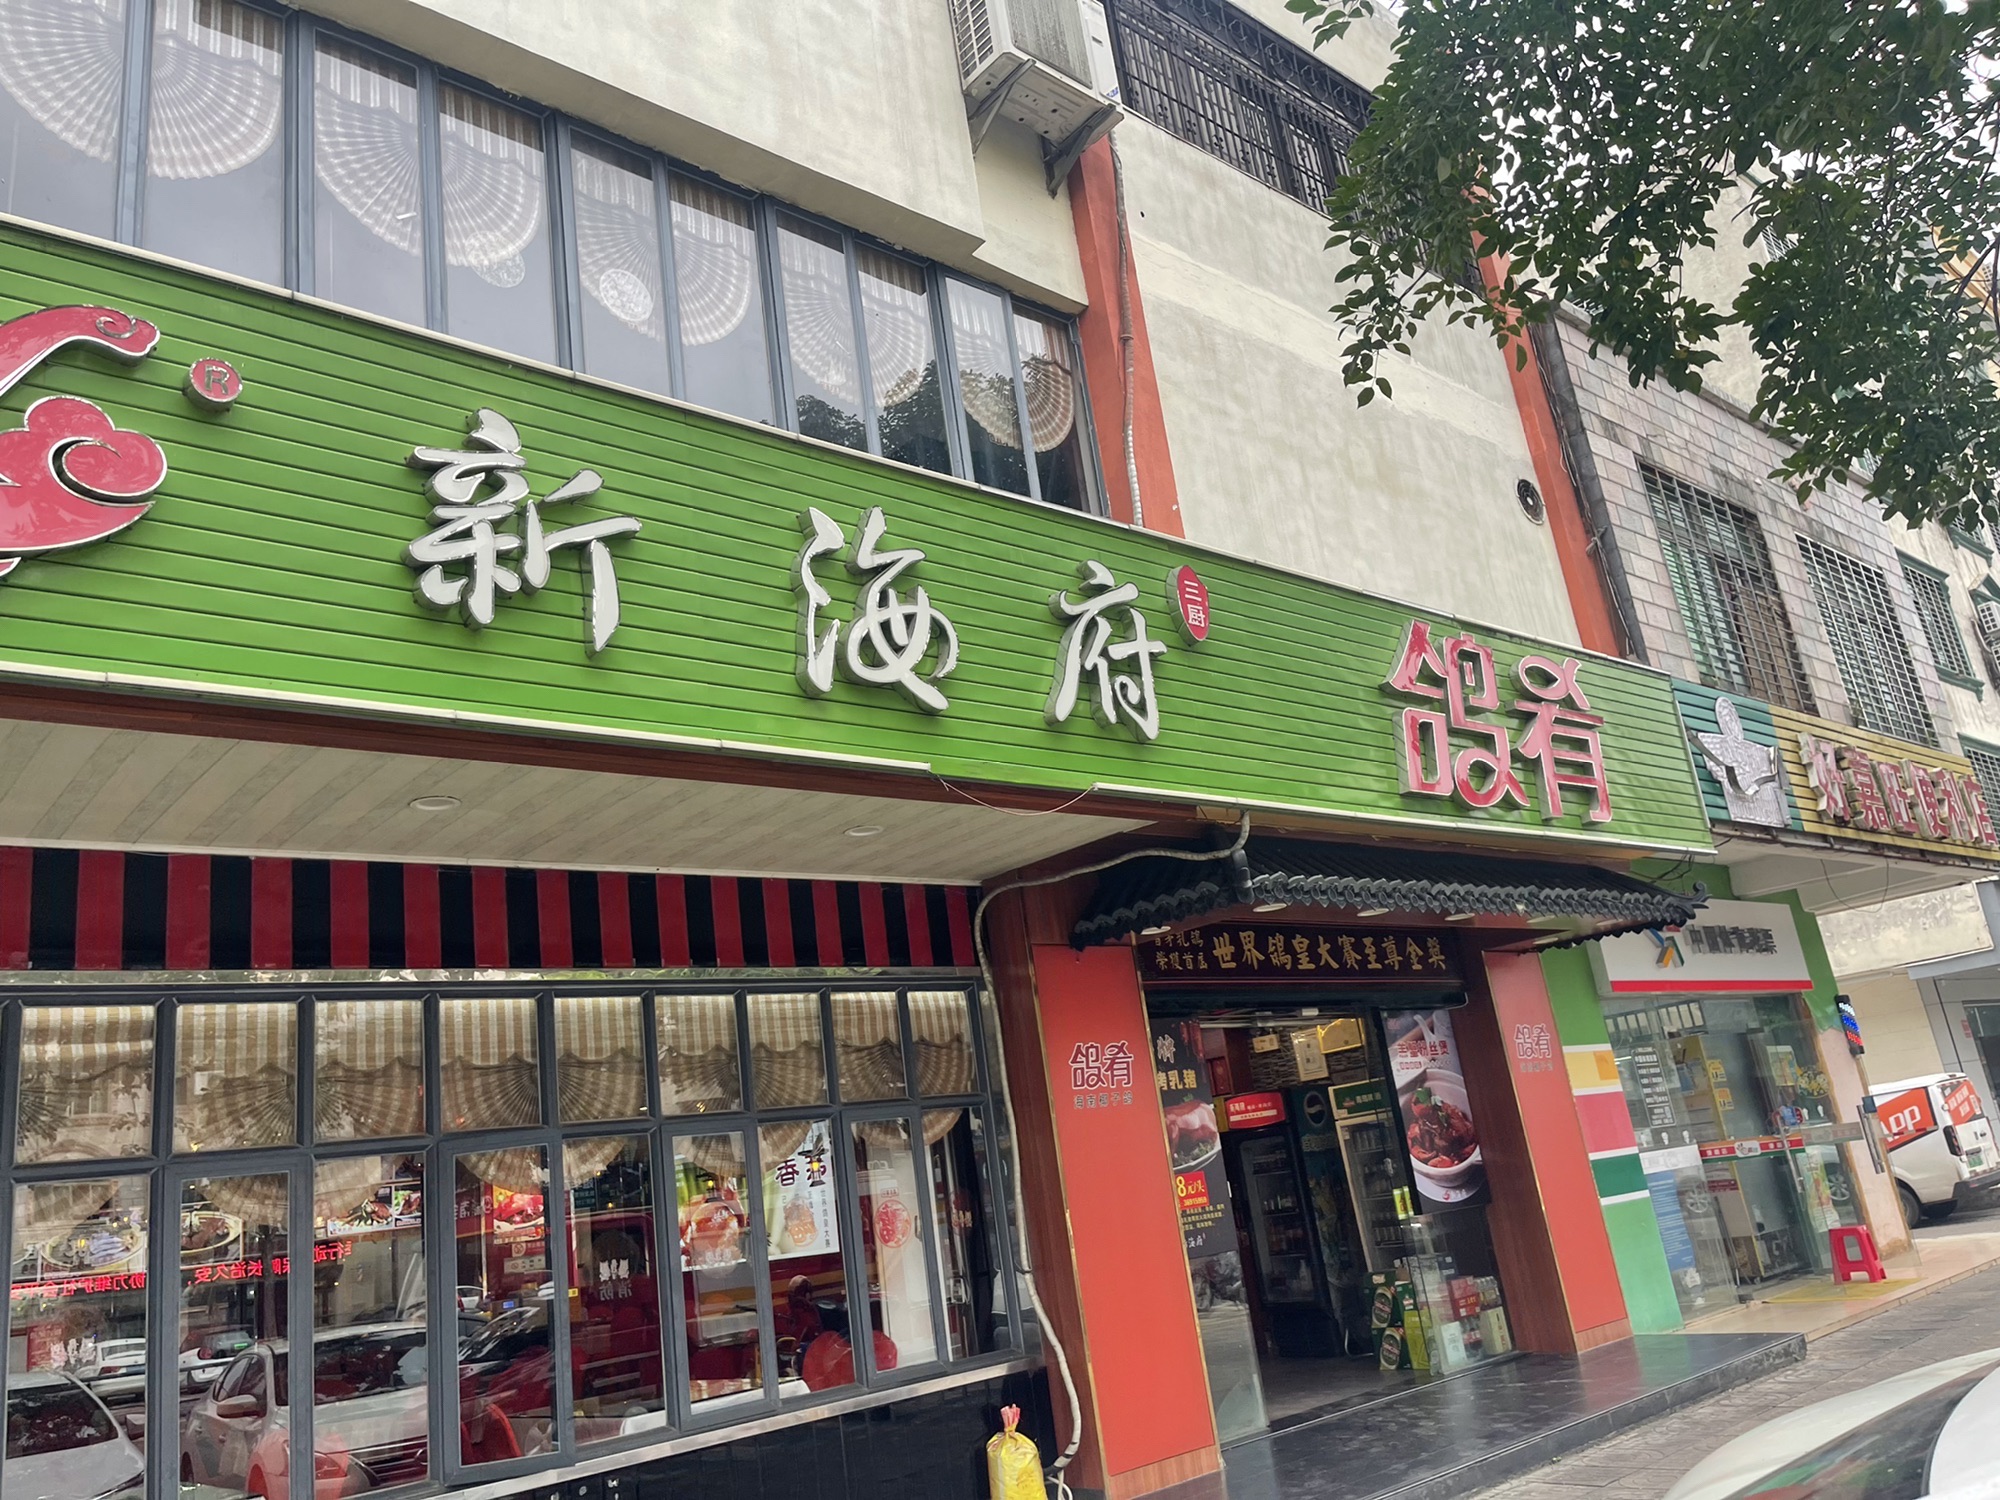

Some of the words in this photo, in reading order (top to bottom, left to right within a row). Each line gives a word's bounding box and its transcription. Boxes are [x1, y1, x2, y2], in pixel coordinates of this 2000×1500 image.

[402, 407, 1167, 743] 新海府
[1185, 1234, 1203, 1248] 海府
